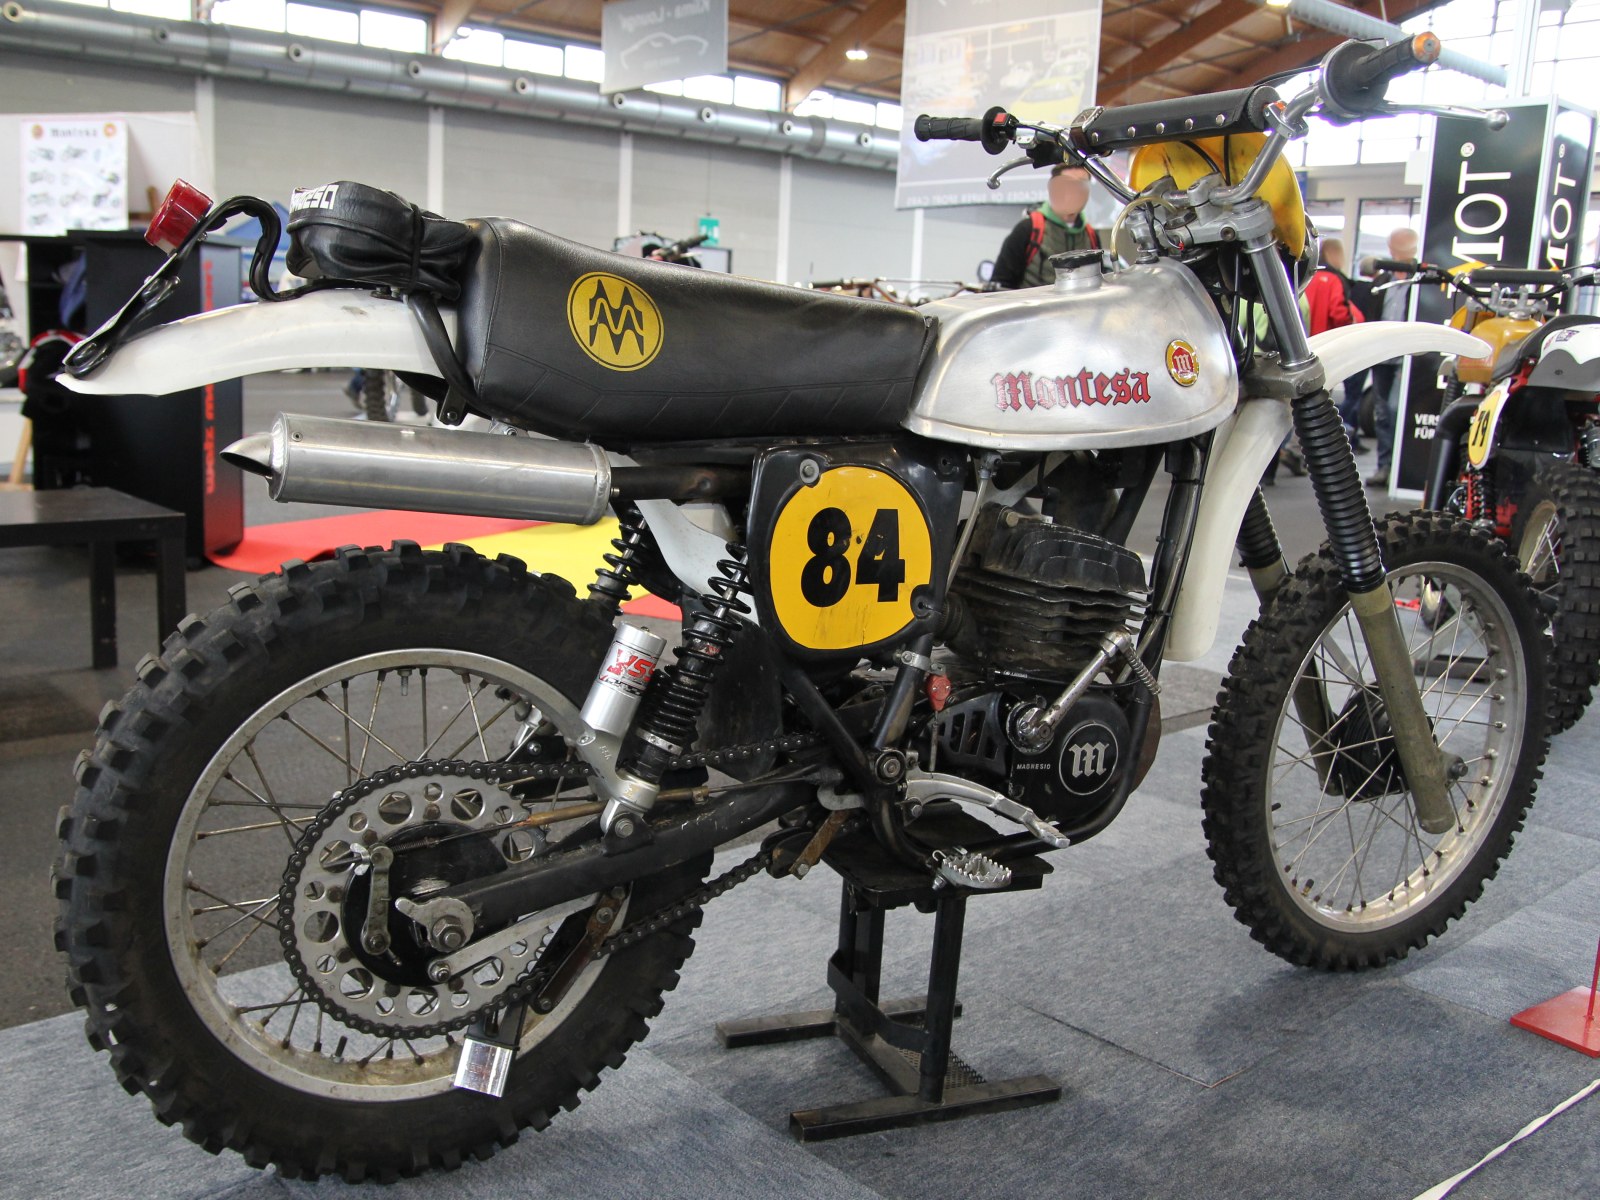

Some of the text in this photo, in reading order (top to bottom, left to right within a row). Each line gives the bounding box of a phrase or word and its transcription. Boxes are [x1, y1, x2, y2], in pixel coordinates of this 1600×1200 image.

[990, 366, 1152, 412] Montesa
[1472, 410, 1491, 447] 79
[801, 507, 905, 608] 84
[1016, 763, 1051, 771] MAGNESIO
